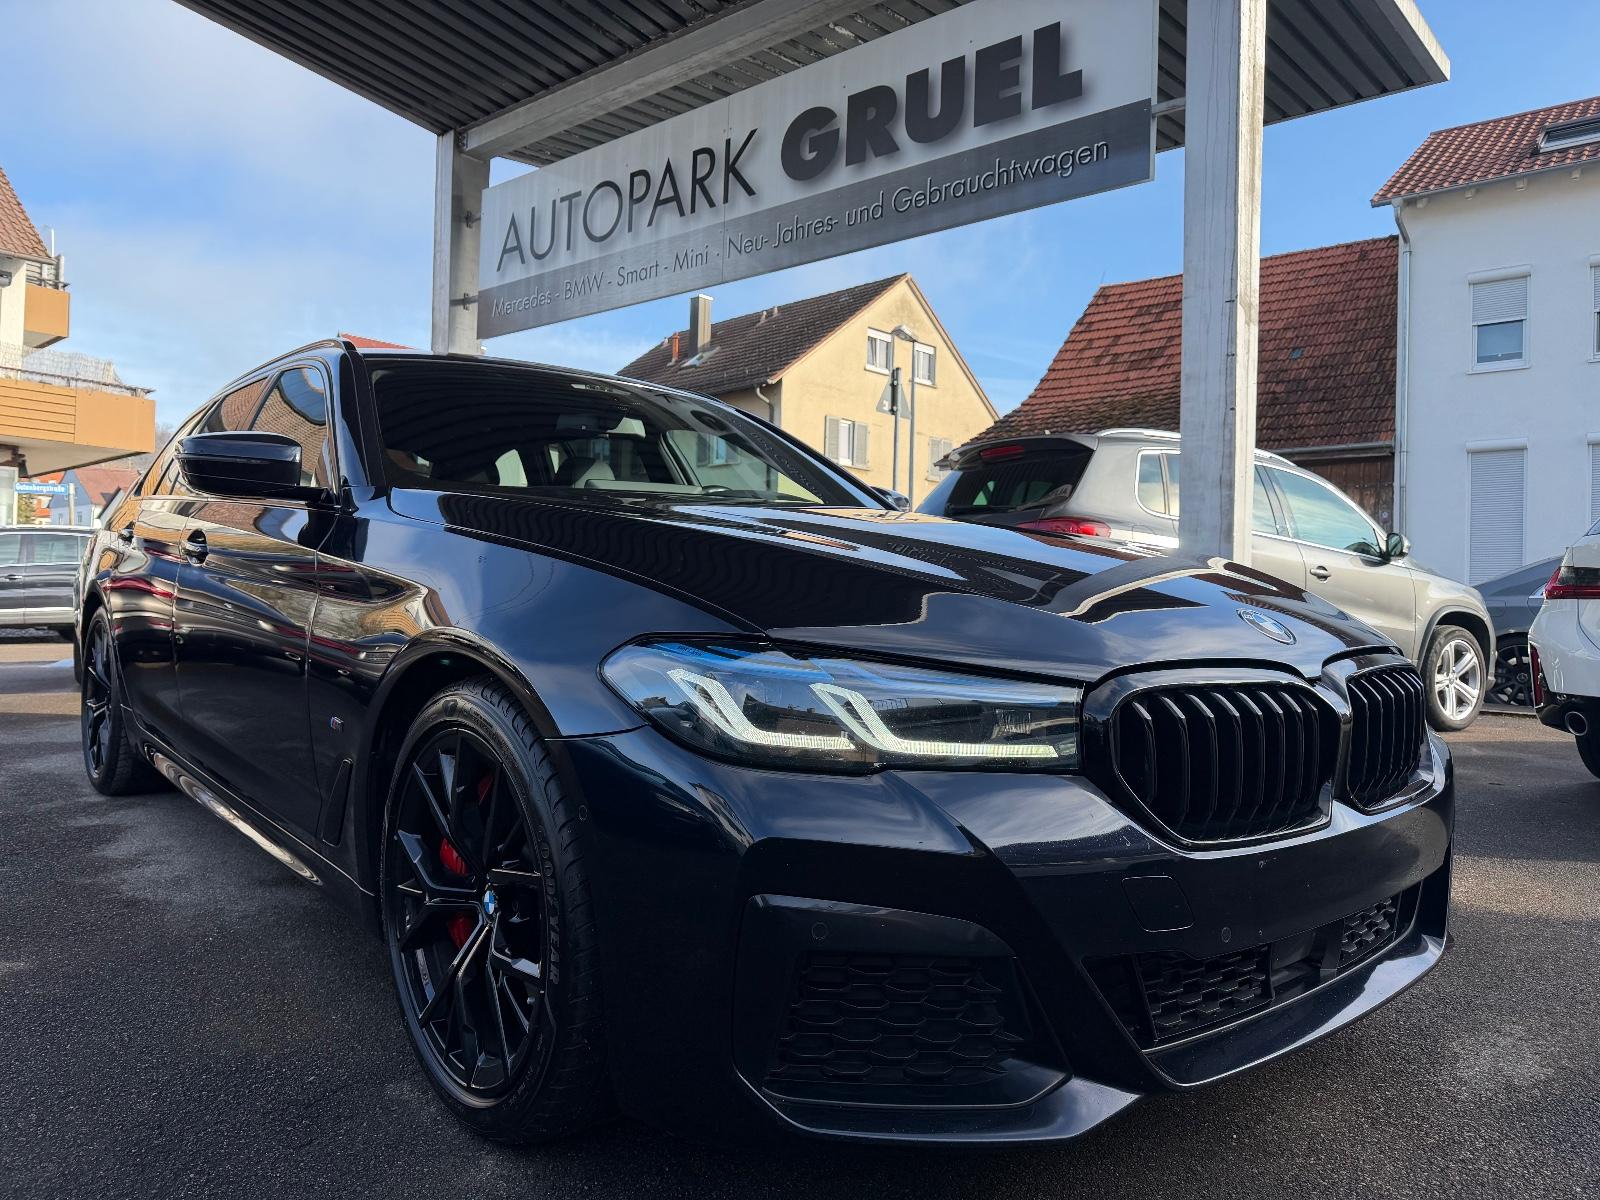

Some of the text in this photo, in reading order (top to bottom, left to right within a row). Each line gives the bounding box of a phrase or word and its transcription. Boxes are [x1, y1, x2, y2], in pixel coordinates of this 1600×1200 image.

[491, 286, 552, 318] Mercedes
[564, 271, 604, 300] BMW
[617, 259, 659, 287] Smart
[673, 245, 709, 273] Mini
[727, 232, 769, 259] Neu-
[772, 214, 839, 249] Jahres-
[845, 190, 884, 227] und
[891, 140, 1110, 213] Gebrauchtwagen
[496, 21, 1083, 272] AUTOPARK GRUEL
